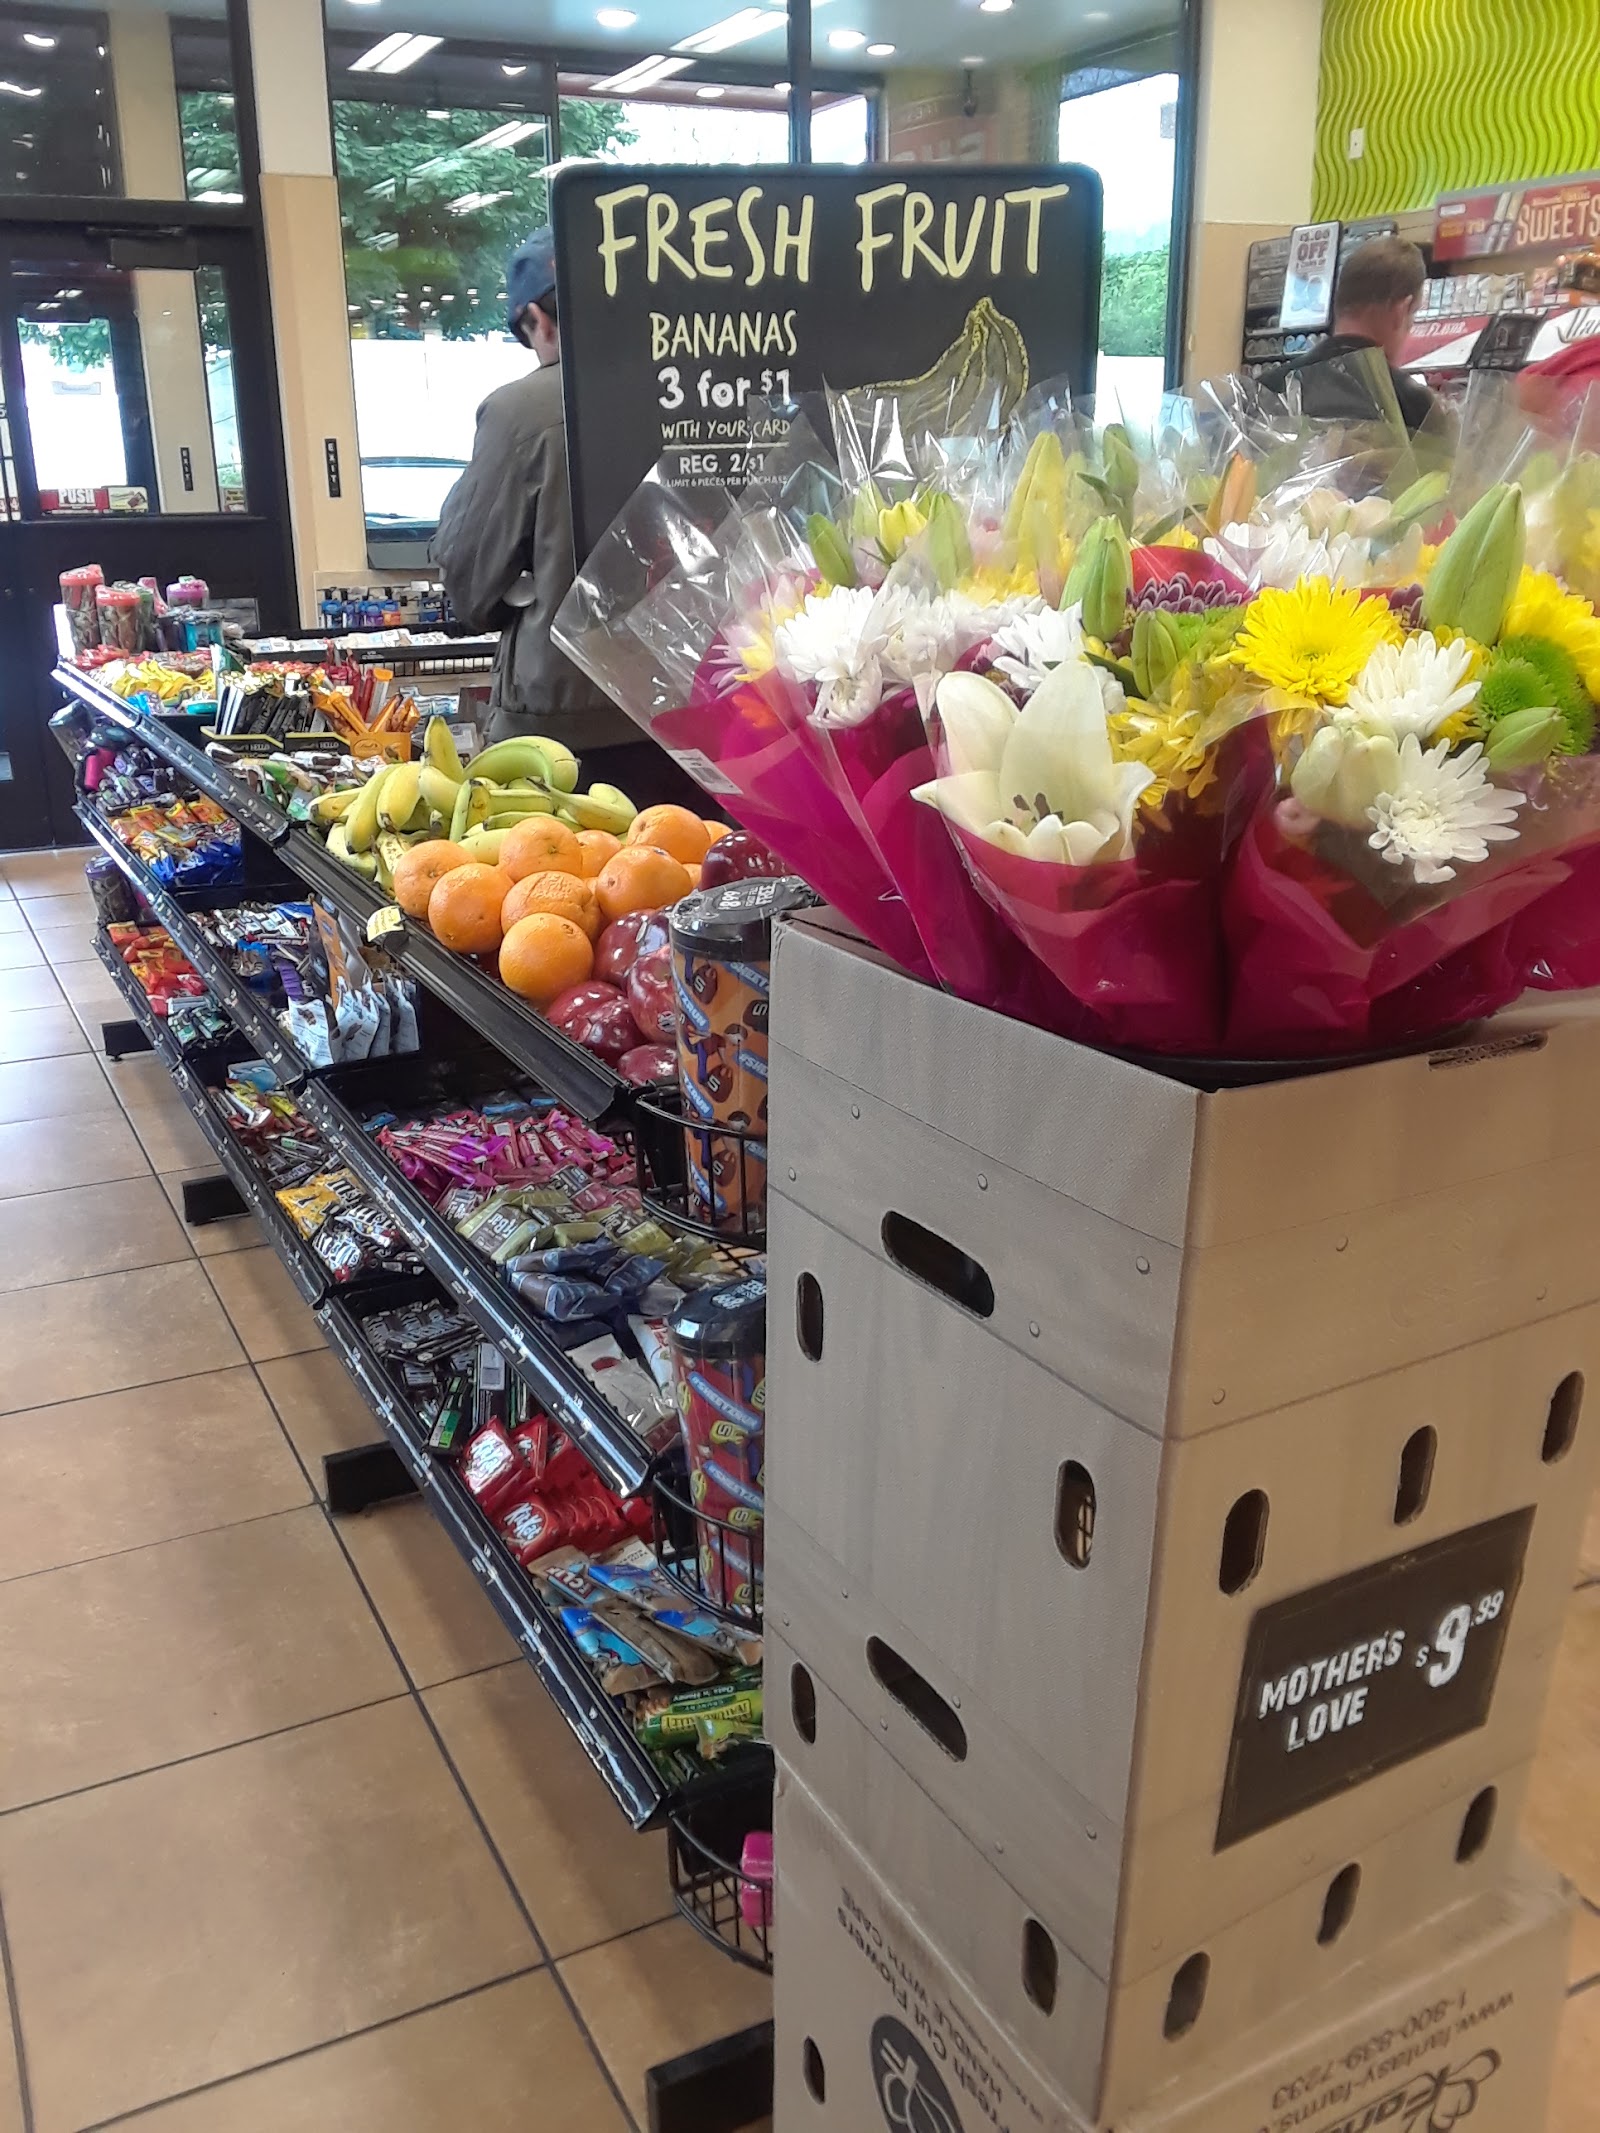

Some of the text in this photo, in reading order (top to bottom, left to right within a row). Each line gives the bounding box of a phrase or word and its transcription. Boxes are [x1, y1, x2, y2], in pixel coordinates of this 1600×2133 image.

[595, 183, 1070, 296] FRESH FRUIT
[1297, 241, 1328, 261] OFF
[650, 309, 799, 361] BANANAS
[657, 366, 791, 409] 3 for $1
[661, 419, 790, 439] WITH YOUR CARD
[327, 442, 337, 483] EXIT
[667, 479, 690, 487] LIMIT
[691, 478, 697, 487] 6
[698, 477, 726, 486] PIECES
[726, 476, 742, 485] PER
[679, 452, 764, 474] REG. 2/$1
[58, 488, 95, 505] PUSH
[1258, 1590, 1505, 1719] MOTHER'S $9.99
[1286, 1687, 1369, 1752] LOVE
[841, 1887, 883, 1948] CARE
[837, 1906, 908, 2010] Flowers
[887, 1947, 927, 2007] WITH
[914, 2004, 947, 2061] Cut
